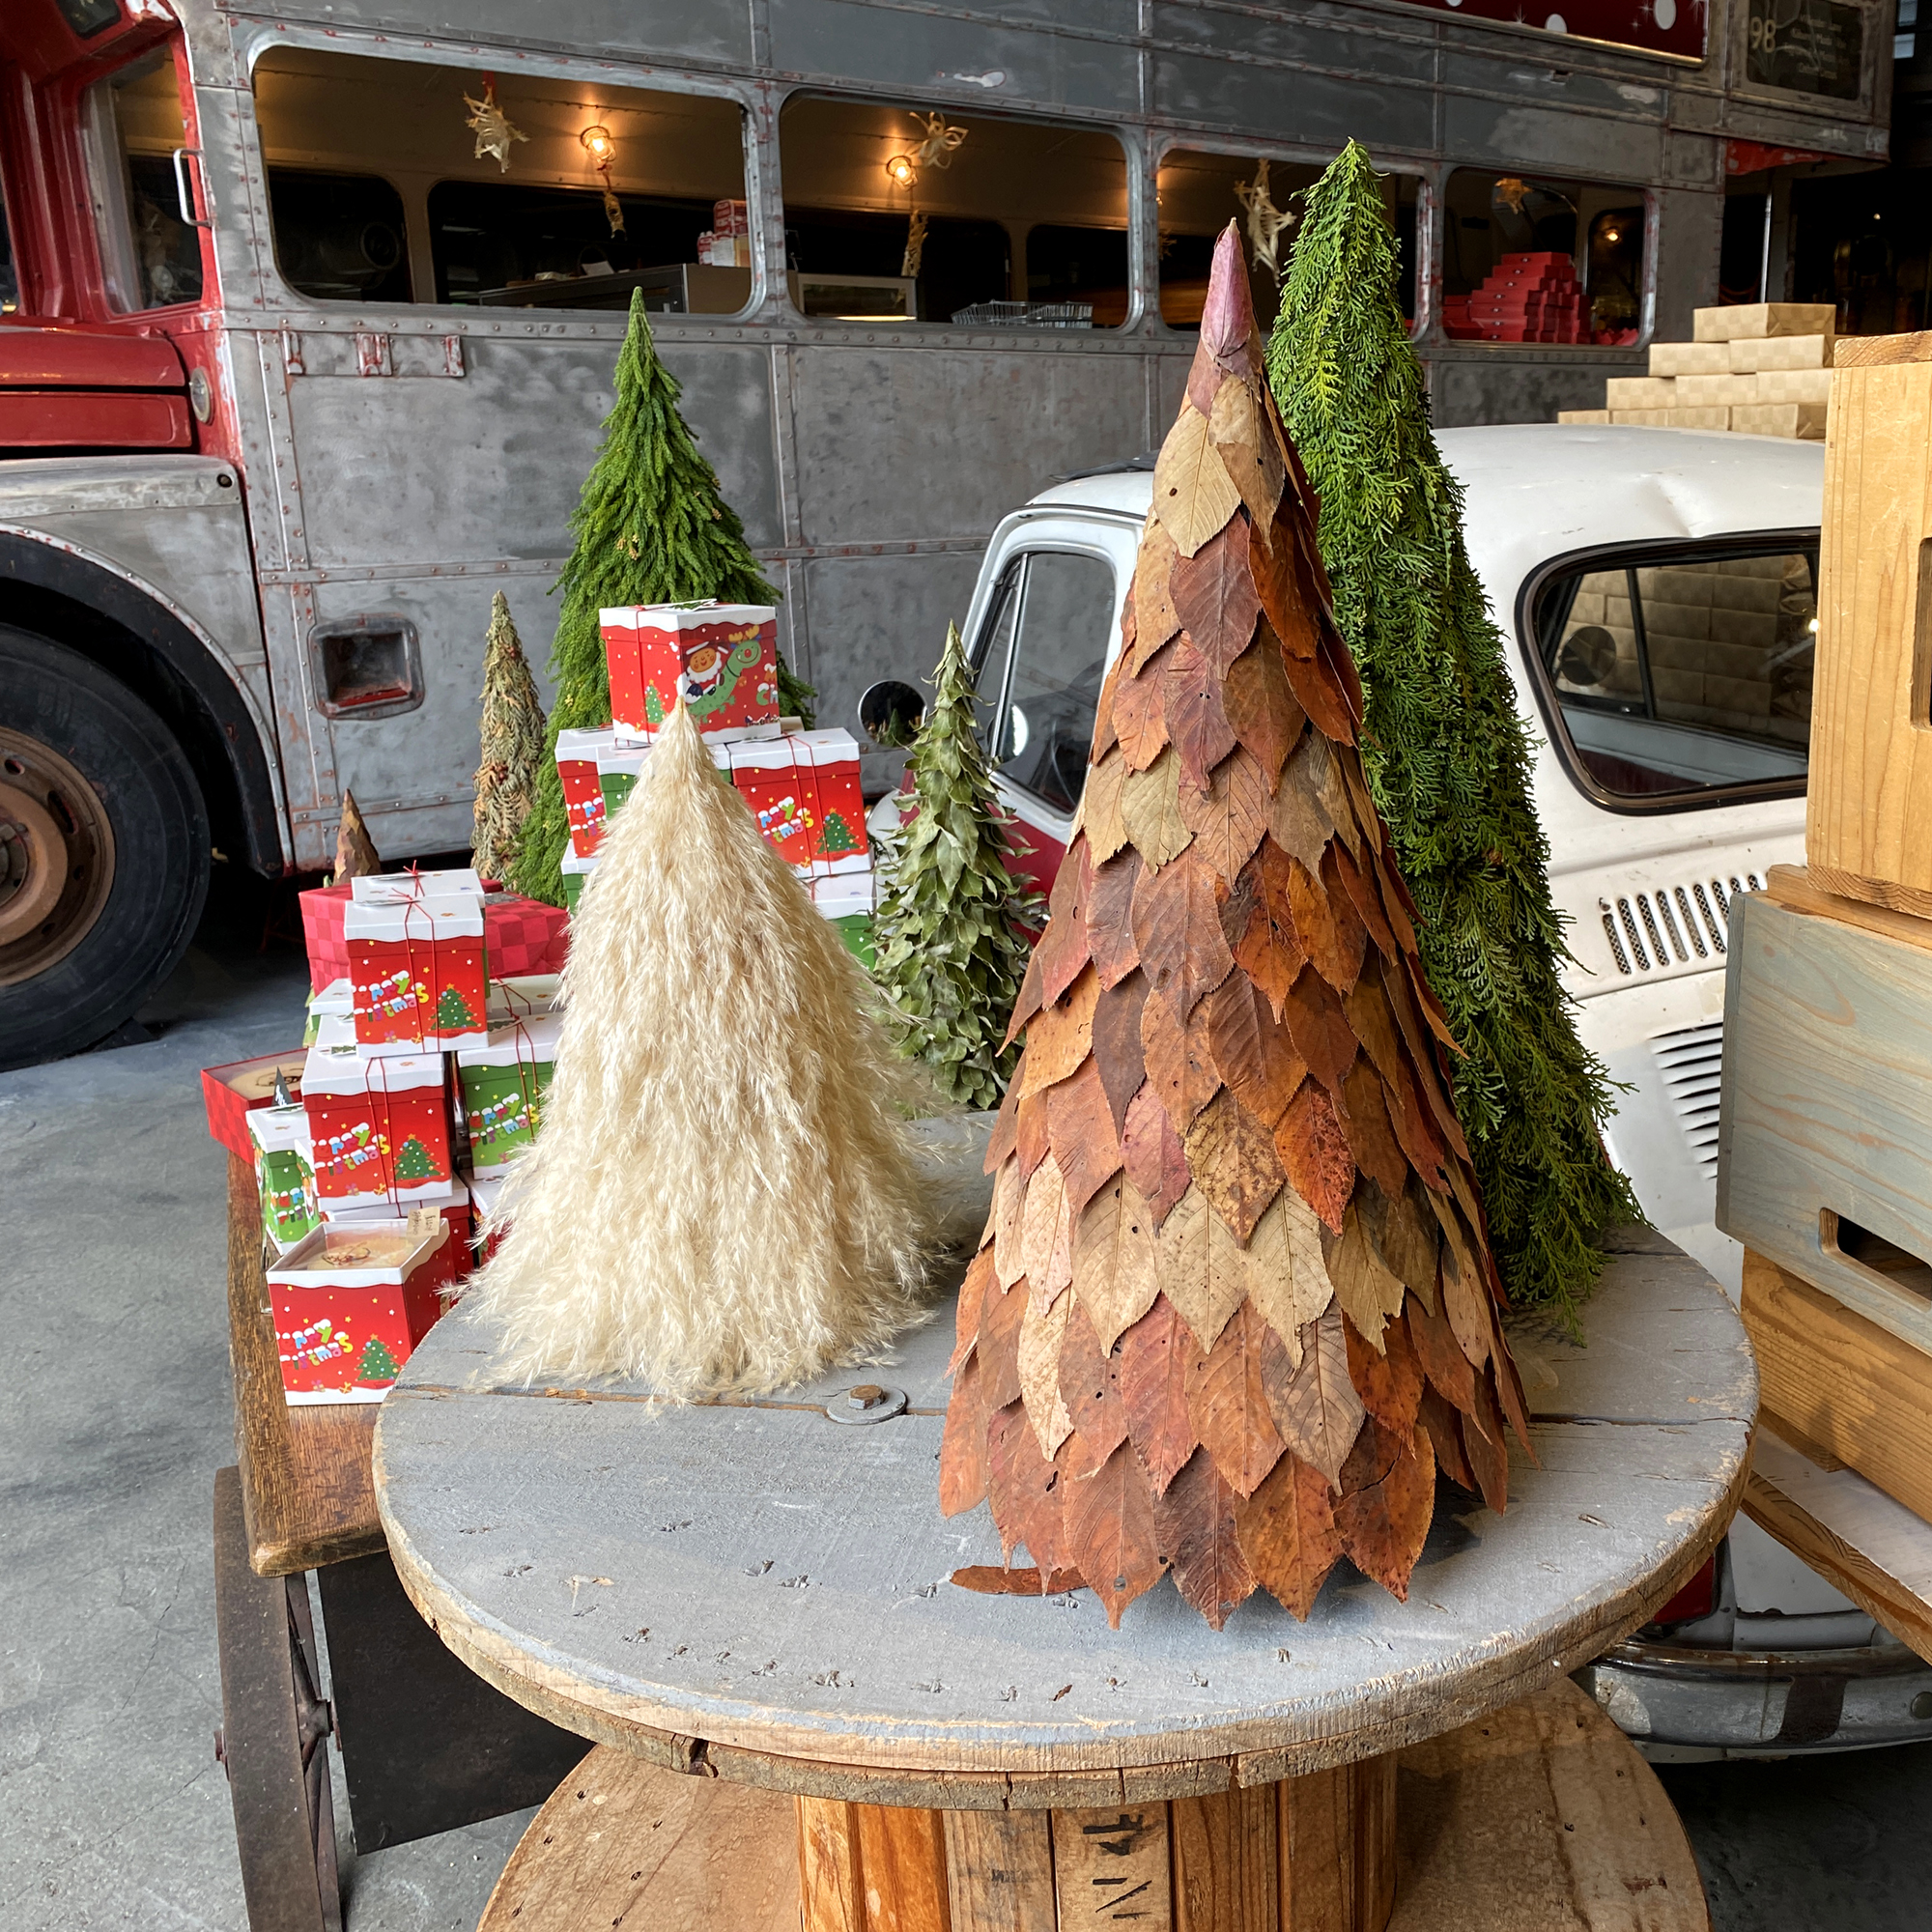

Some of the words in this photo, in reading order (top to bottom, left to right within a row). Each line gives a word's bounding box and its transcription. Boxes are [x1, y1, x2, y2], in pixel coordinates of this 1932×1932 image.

[1749, 16, 1776, 53] 98
[469, 1093, 521, 1128] erry
[469, 1103, 539, 1148] ristmas
